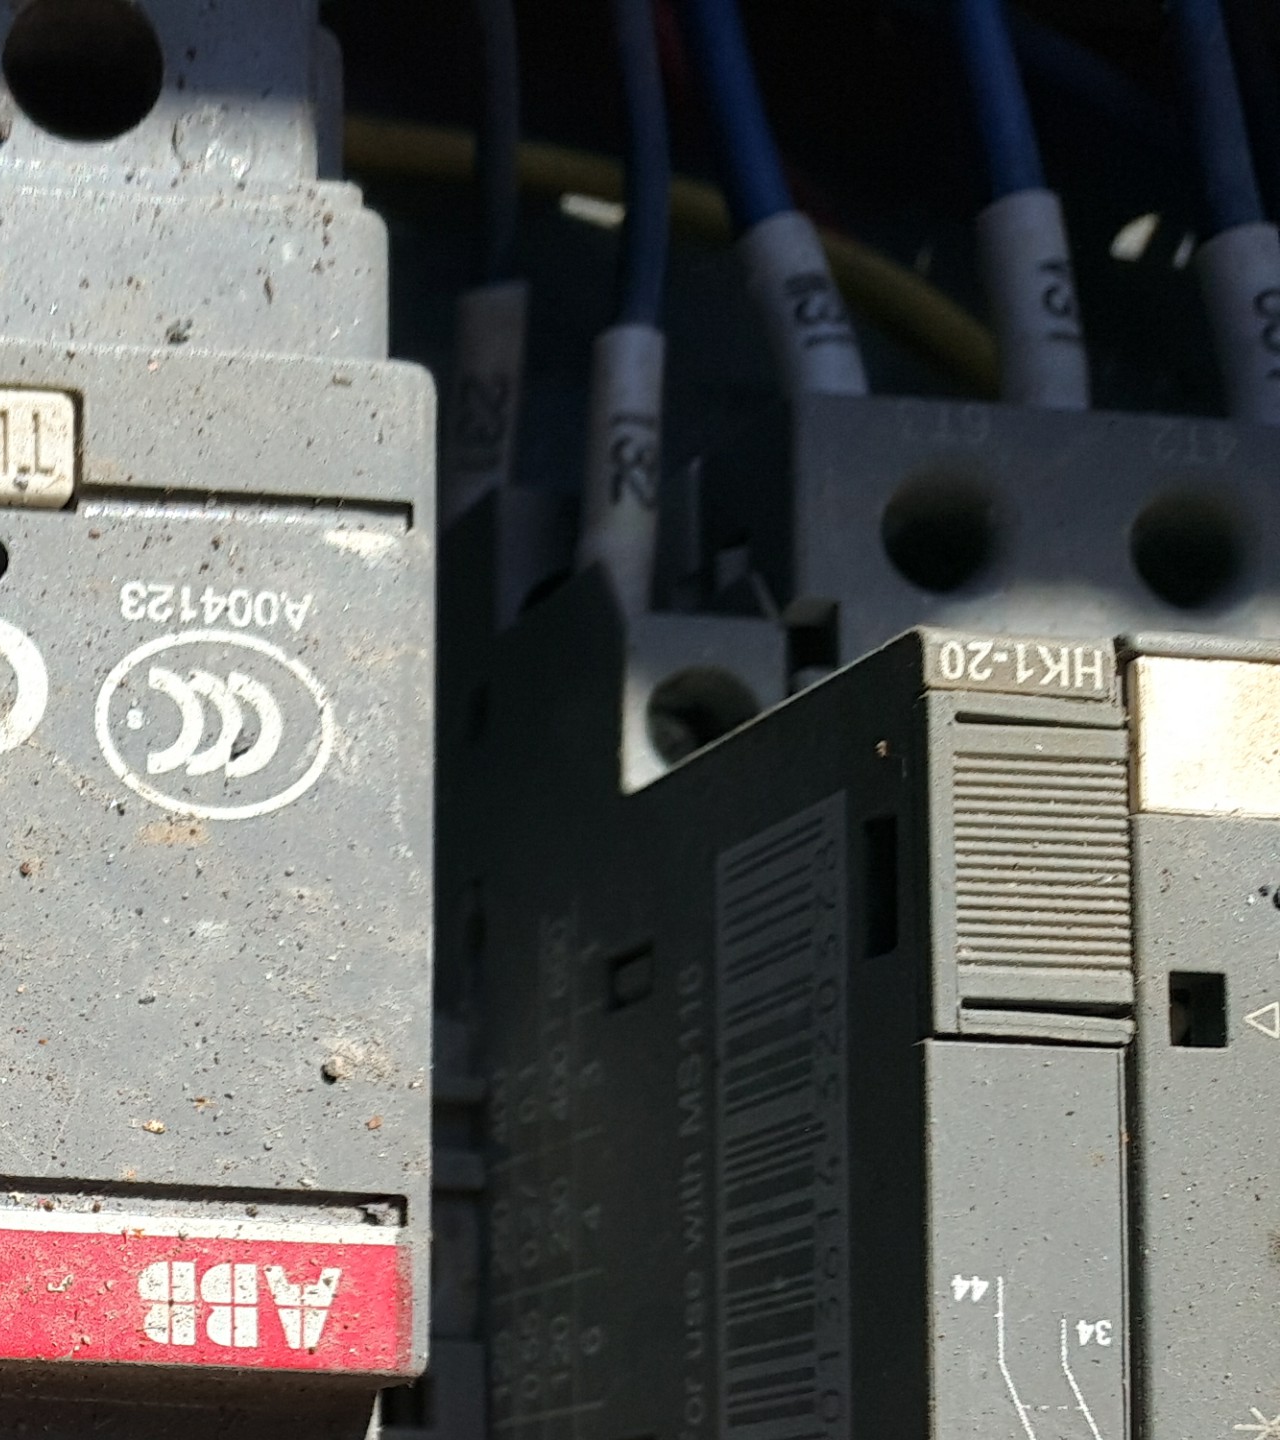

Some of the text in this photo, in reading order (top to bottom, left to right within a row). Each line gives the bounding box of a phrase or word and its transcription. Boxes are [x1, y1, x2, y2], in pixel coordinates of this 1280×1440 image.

[120, 579, 314, 631] A004123
[939, 639, 1104, 690] HK1-20
[677, 961, 703, 1138] MS116
[679, 1151, 703, 1252] with
[138, 1260, 342, 1350] ABB
[683, 1270, 705, 1360] use
[951, 1273, 989, 1301] 44
[1075, 1320, 1113, 1346] 34
